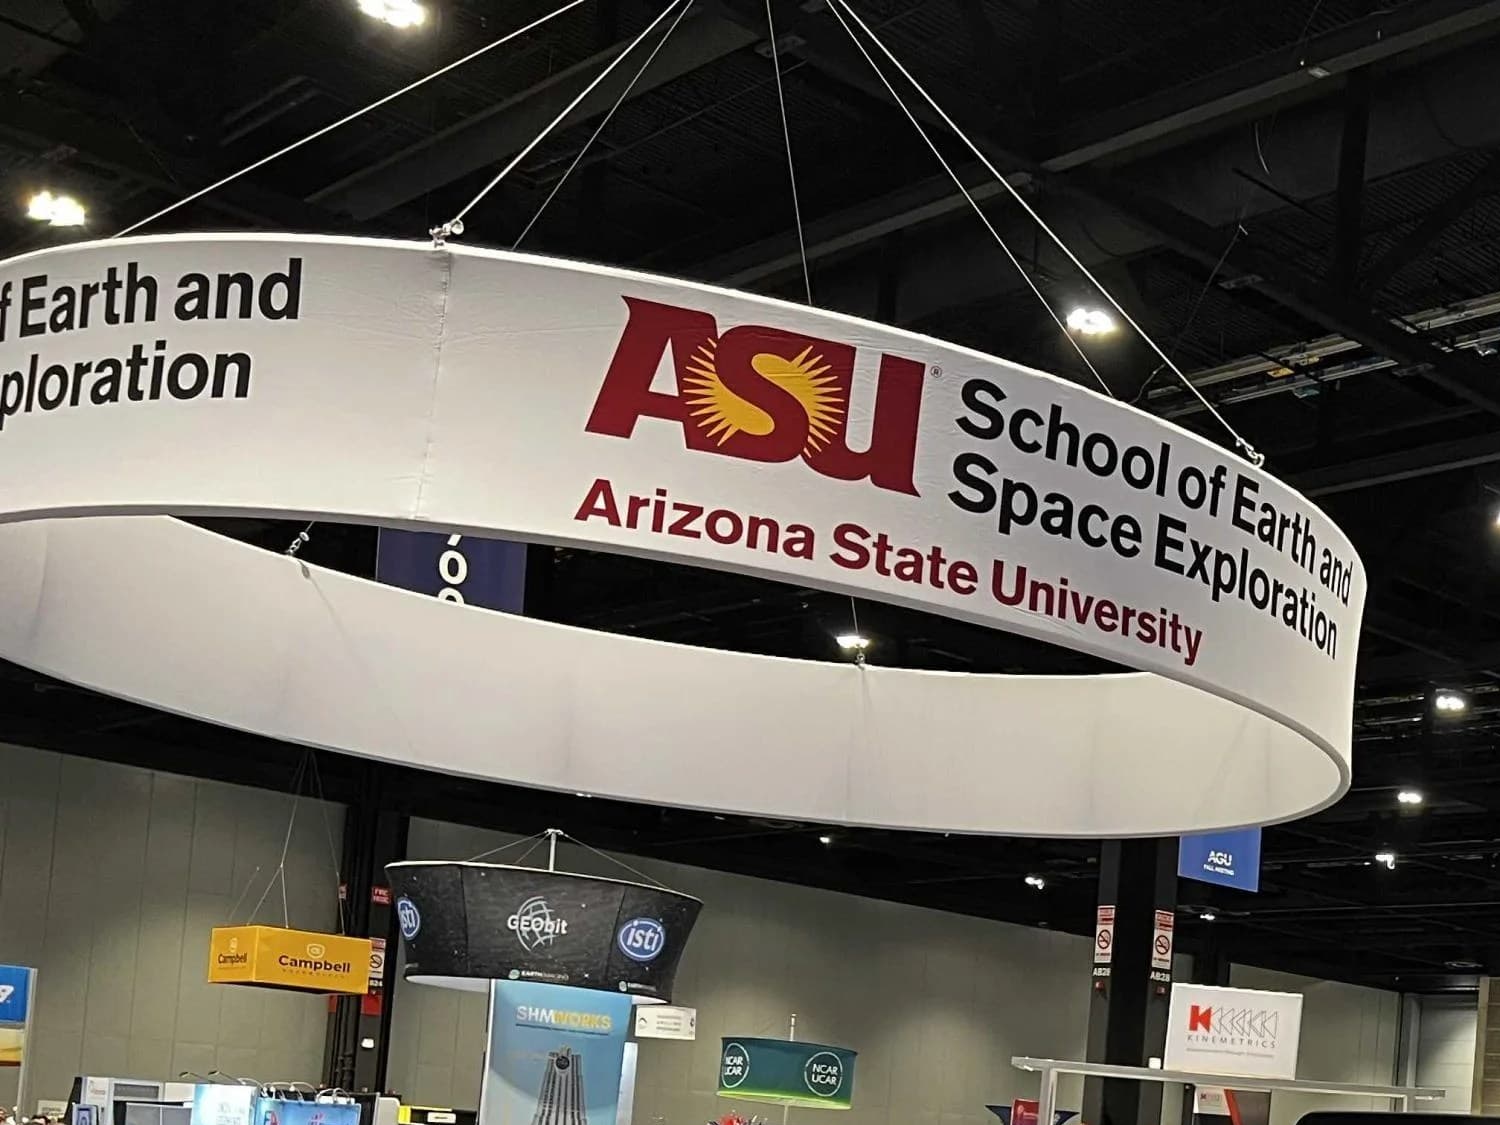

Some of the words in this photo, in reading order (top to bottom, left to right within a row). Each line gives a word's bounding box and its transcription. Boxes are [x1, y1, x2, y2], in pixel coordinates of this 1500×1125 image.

[19, 261, 158, 337] Earth
[173, 257, 302, 322] and
[0, 340, 252, 430] ploration
[585, 295, 926, 498] ASU
[955, 378, 1170, 497] School
[1178, 464, 1228, 517] of
[1231, 473, 1316, 574] Earth
[1319, 546, 1353, 609] and
[948, 452, 1142, 558] Space
[1154, 513, 1338, 660] Exploration
[574, 478, 815, 560] Arizona
[829, 522, 979, 595] State
[992, 559, 1202, 666] University
[1207, 850, 1232, 866] AGU
[507, 914, 568, 936] GEObit
[627, 921, 662, 952] isti
[218, 952, 247, 966] Campbell
[278, 954, 351, 974] Campbell
[516, 1005, 613, 1030] SHMWORKS
[1187, 1035, 1276, 1049] KINEMETRICS
[812, 1074, 836, 1085] UCAR
[813, 1064, 838, 1075] NCAR
